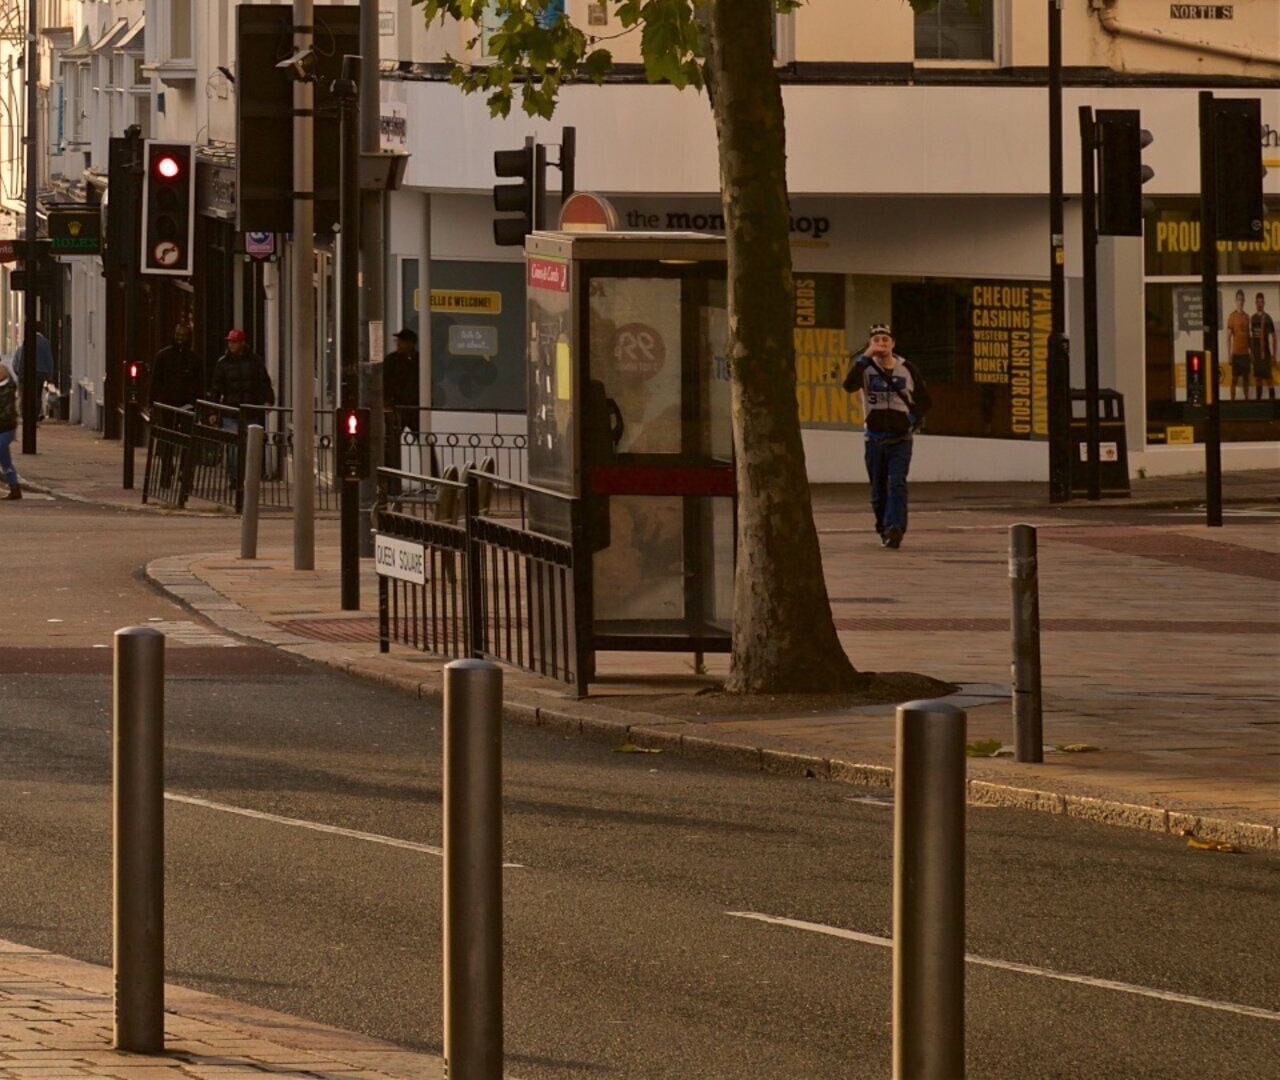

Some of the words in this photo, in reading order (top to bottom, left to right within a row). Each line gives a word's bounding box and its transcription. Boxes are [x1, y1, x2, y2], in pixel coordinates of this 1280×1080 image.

[1172, 6, 1216, 19] NORTH
[626, 209, 660, 229] the
[666, 212, 725, 230] mon
[1156, 221, 1201, 253] PROU
[797, 279, 815, 326] CARDS
[973, 286, 1029, 307] CHEQUE
[973, 310, 1029, 329] CASHING
[974, 330, 1008, 340] WESTERN
[974, 342, 1008, 358] UNION
[1011, 331, 1029, 367] CASH
[974, 358, 1008, 372] MONEY
[974, 373, 1009, 383] TRANSFER
[1011, 370, 1029, 396] FOR
[796, 385, 864, 423] OANS
[1011, 398, 1029, 433] GOLD
